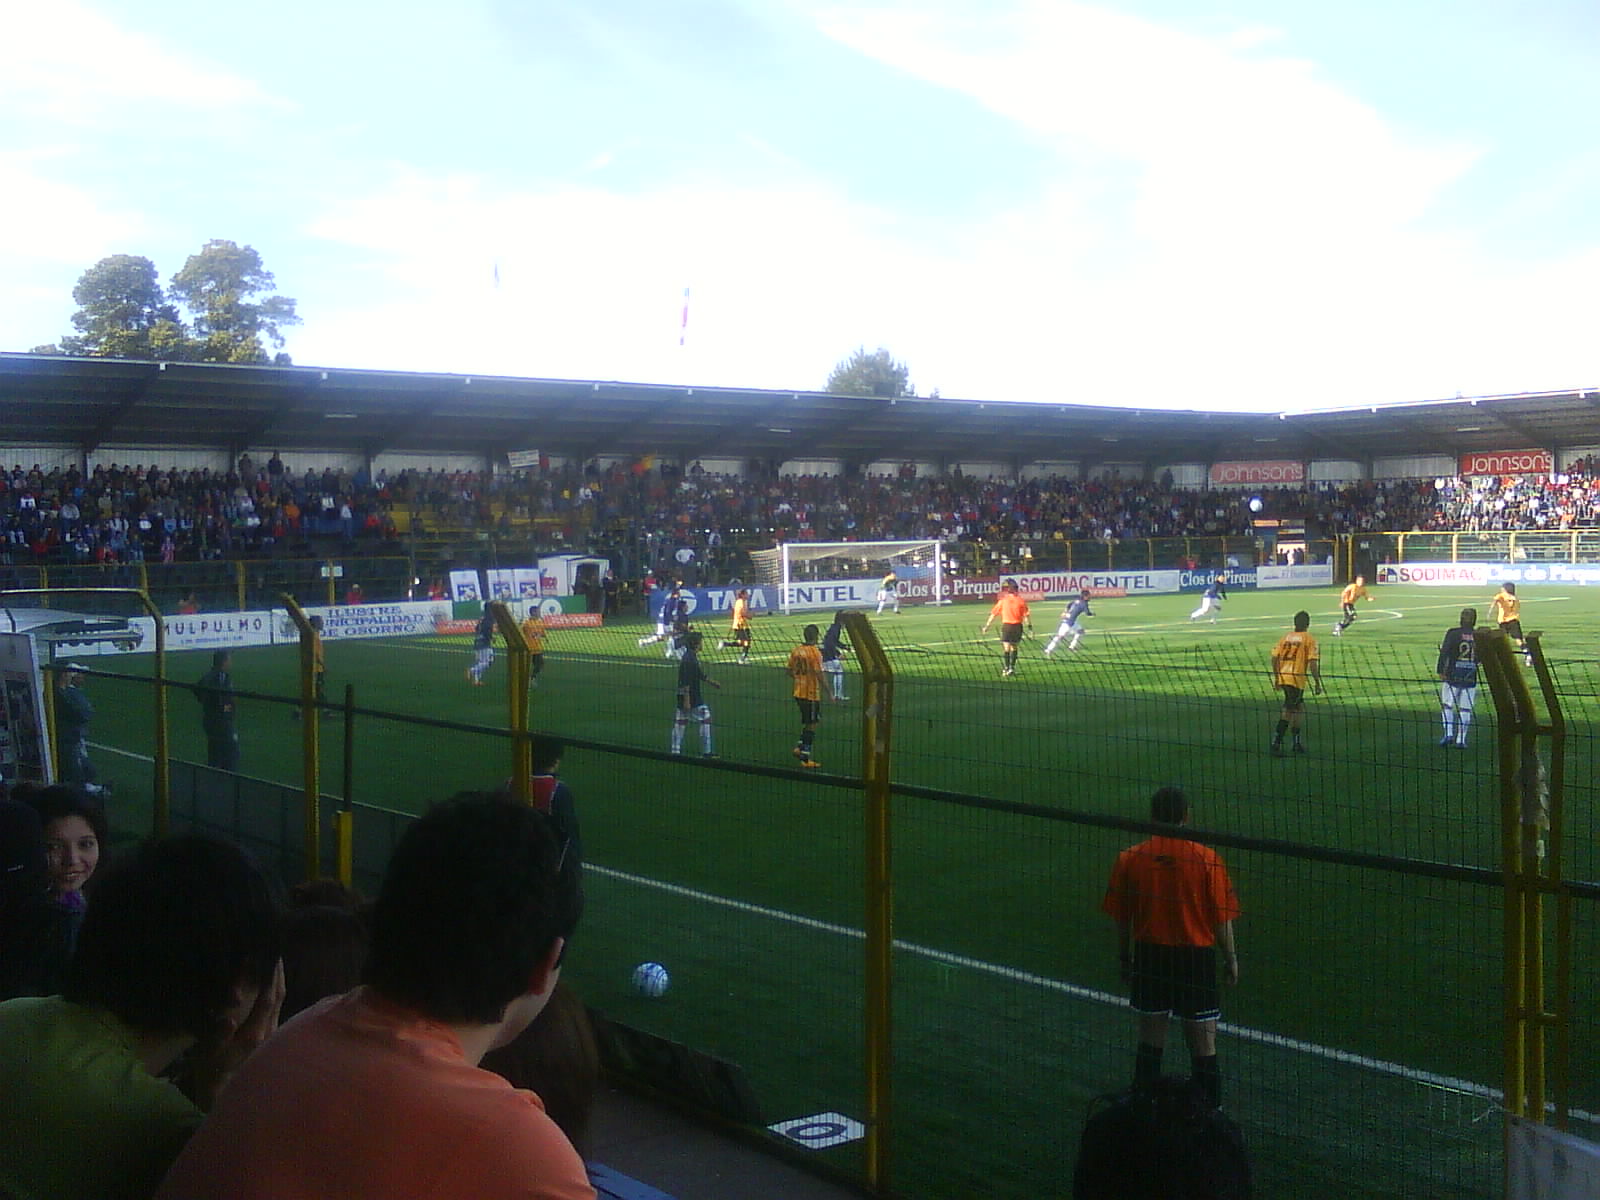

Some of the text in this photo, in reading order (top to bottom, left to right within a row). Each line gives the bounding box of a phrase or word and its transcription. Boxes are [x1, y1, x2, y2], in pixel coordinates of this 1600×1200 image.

[1020, 575, 1089, 593] SODIMAC
[1180, 571, 1205, 587] Clos
[780, 586, 861, 604] ENTEL
[896, 581, 928, 598] Clos
[953, 579, 1000, 600] Pirque
